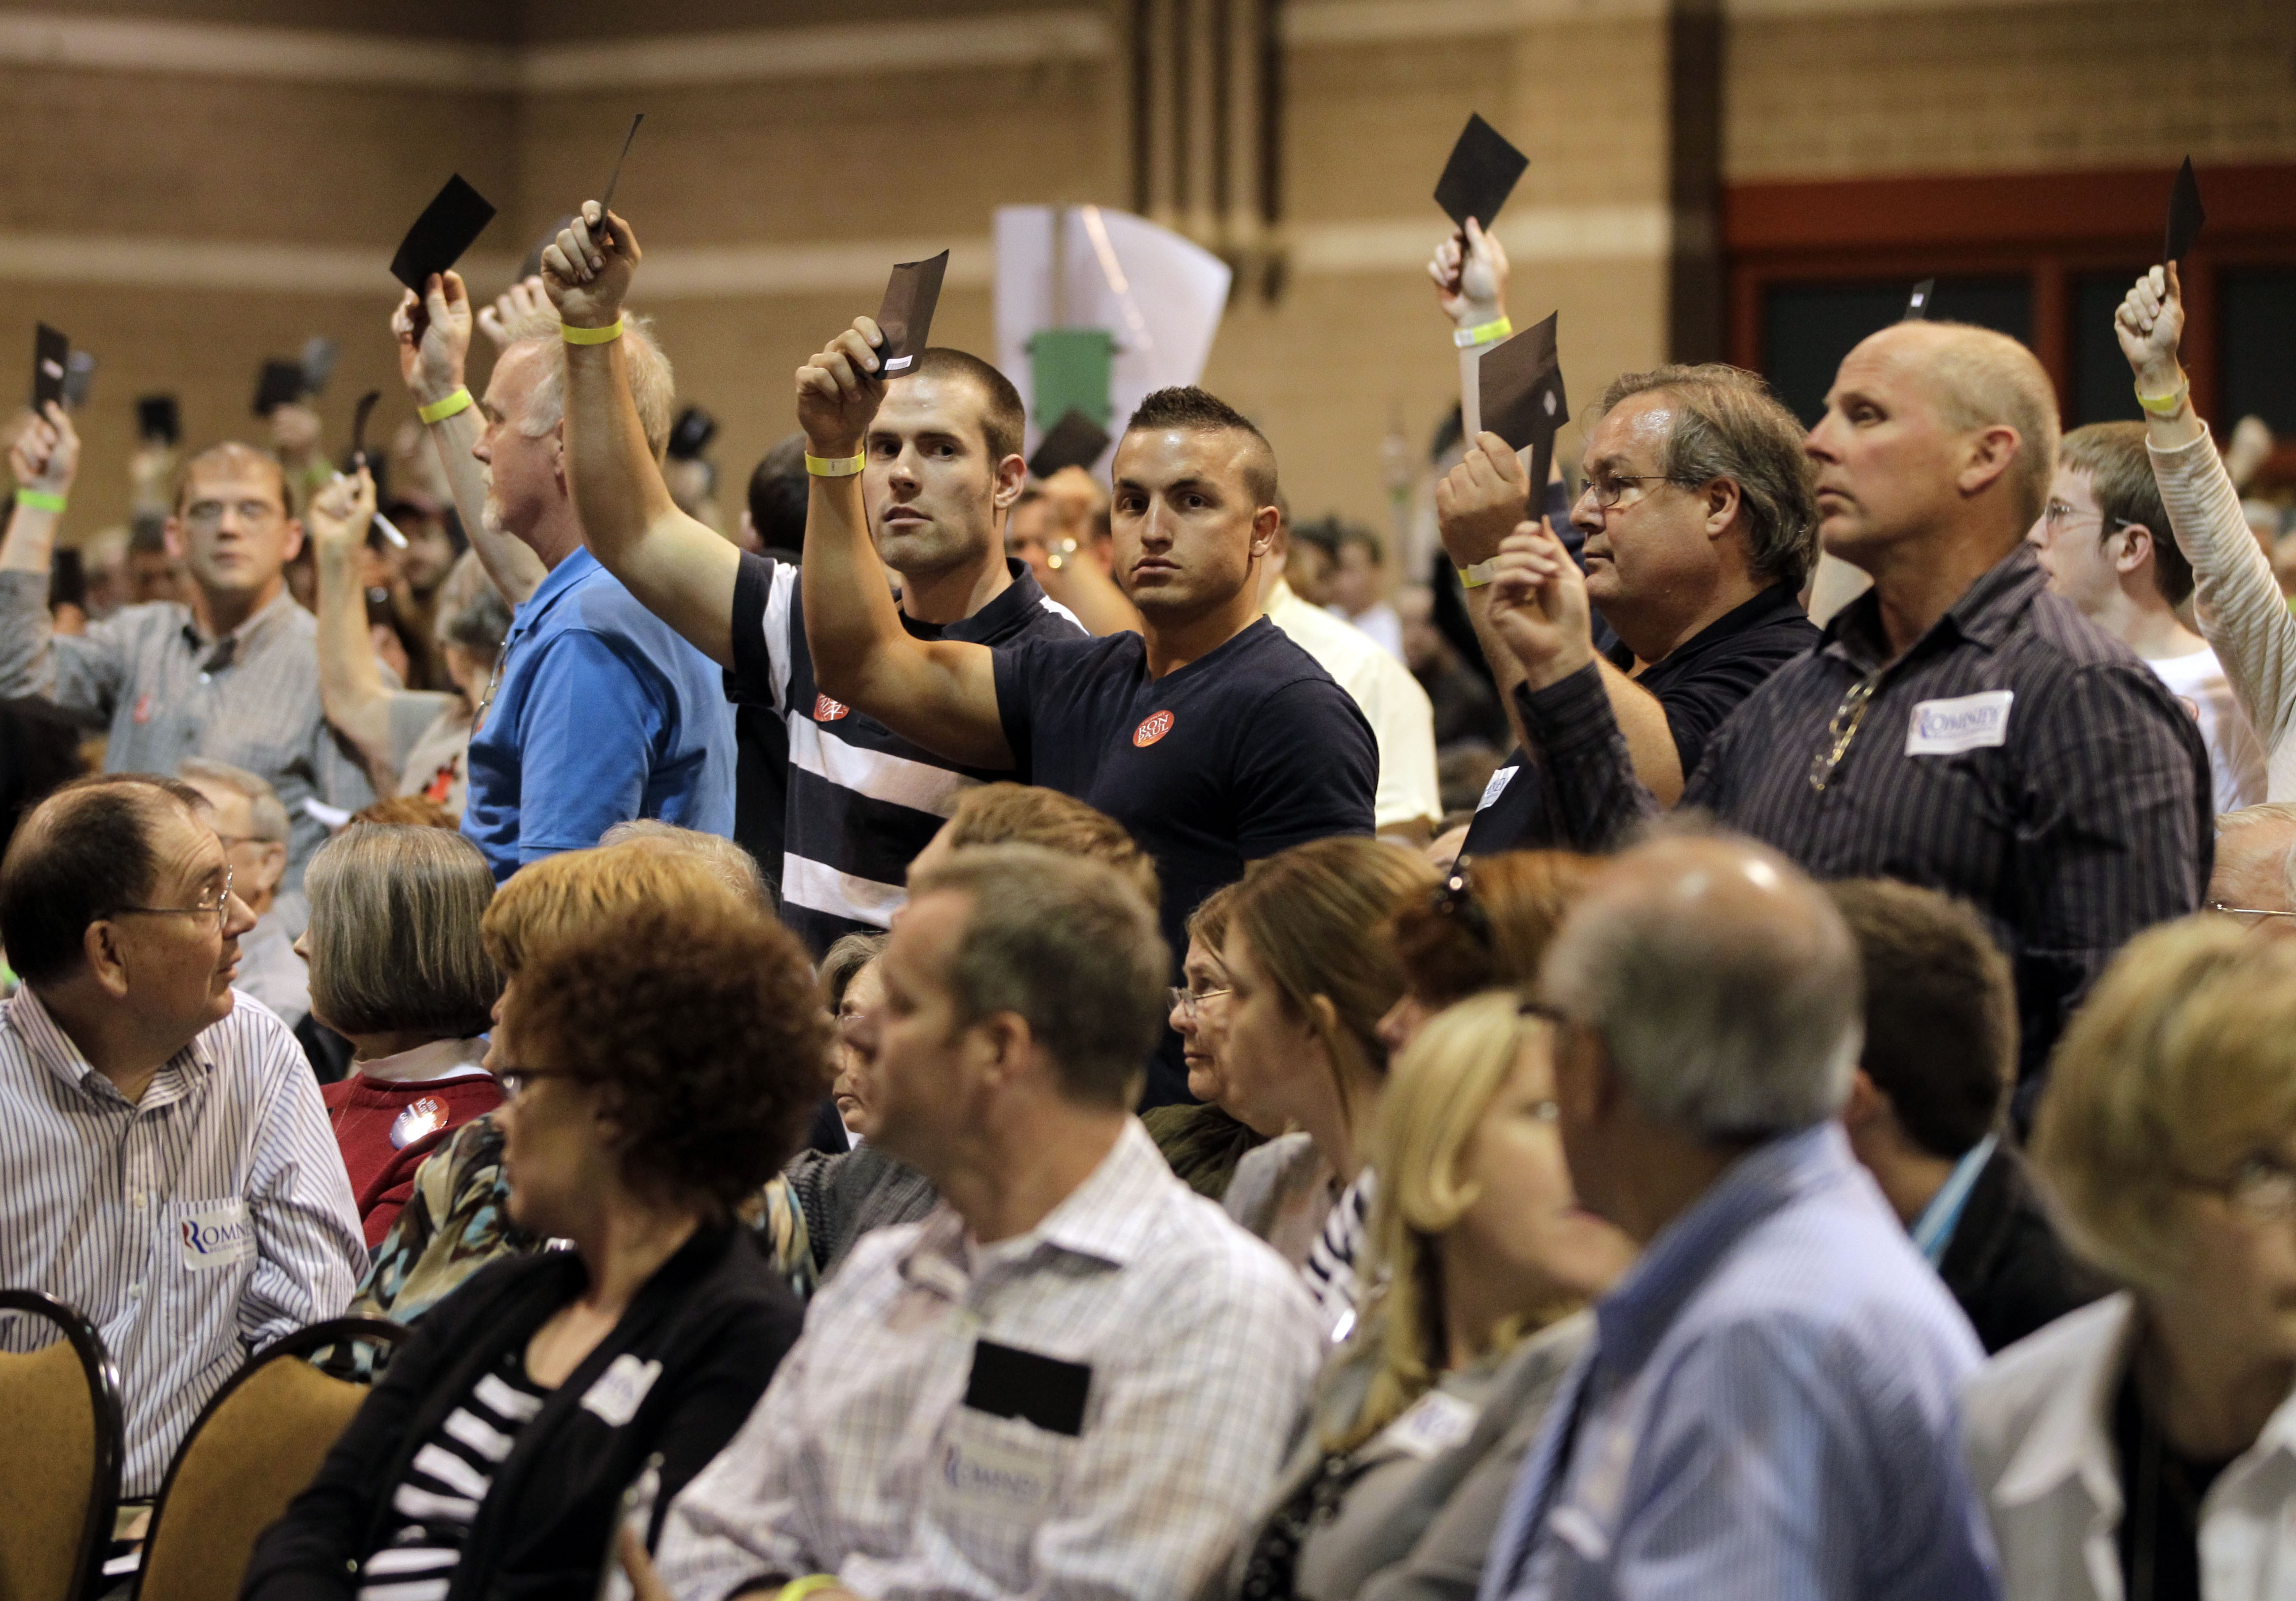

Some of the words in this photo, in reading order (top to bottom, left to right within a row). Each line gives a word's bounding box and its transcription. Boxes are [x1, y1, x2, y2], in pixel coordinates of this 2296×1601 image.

[1137, 723, 1169, 744] PAUL
[1139, 714, 1169, 735] RON
[426, 1099, 438, 1112] Bill
